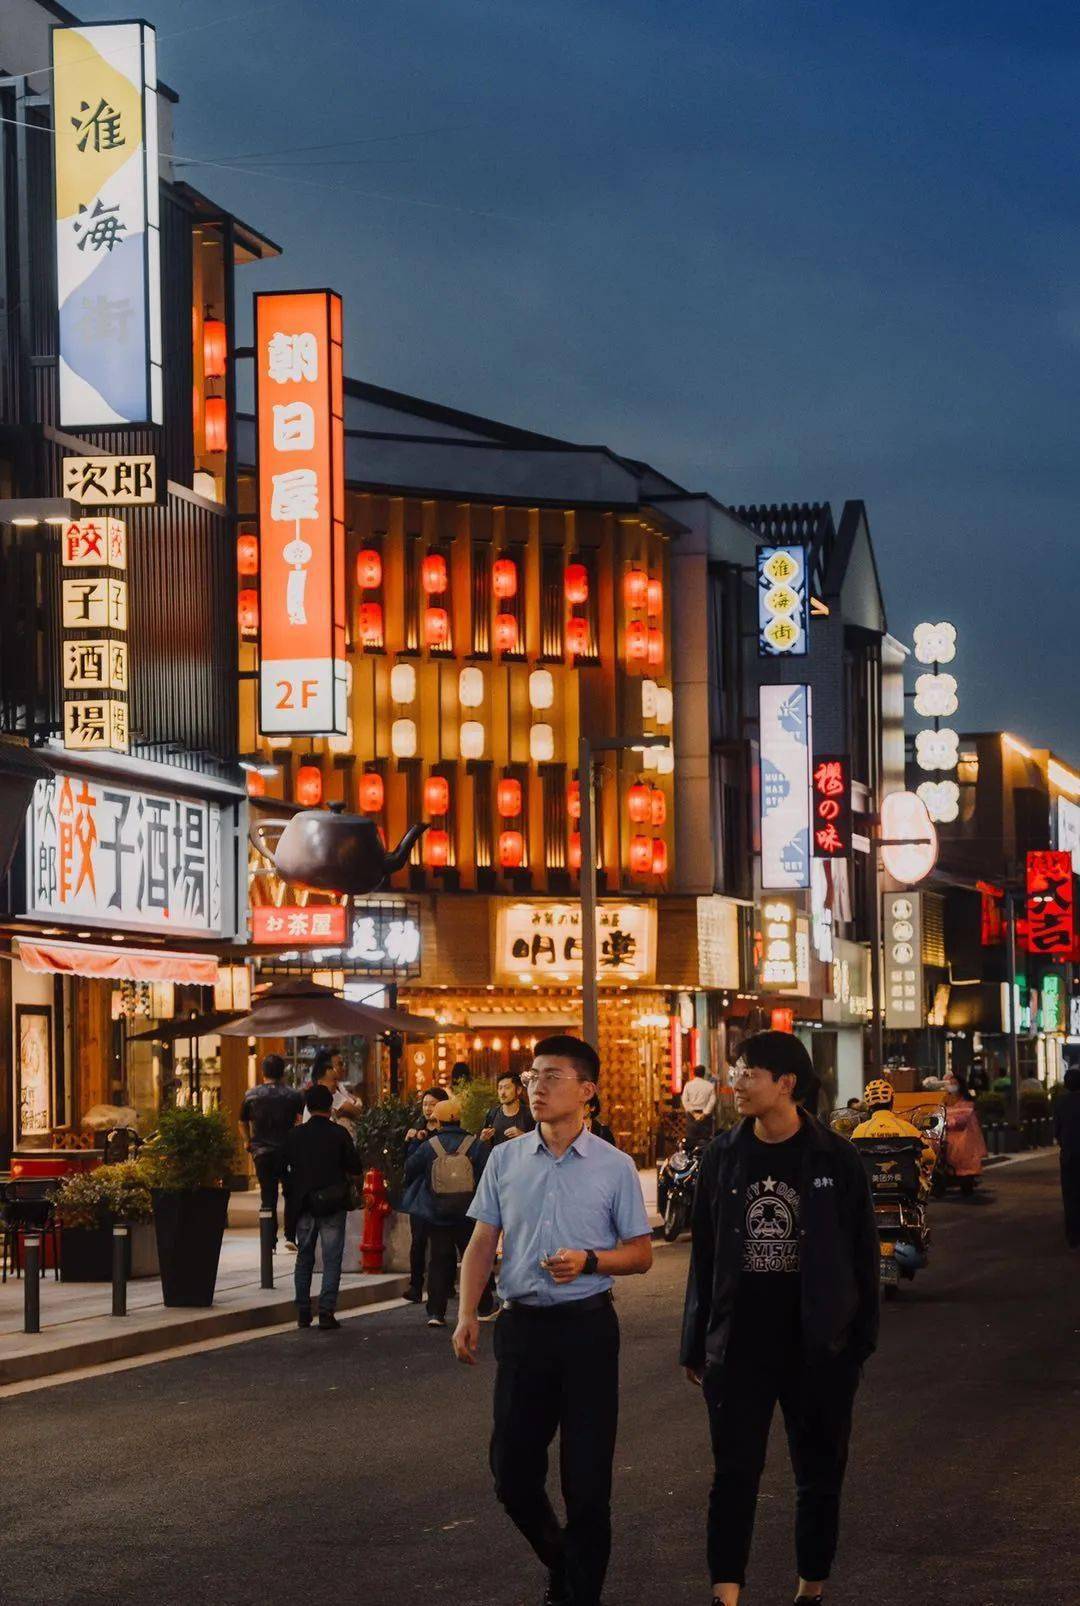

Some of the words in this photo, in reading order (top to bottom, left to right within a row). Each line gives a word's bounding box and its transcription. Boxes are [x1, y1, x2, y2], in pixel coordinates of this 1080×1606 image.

[71, 97, 135, 342] 淮海街
[66, 462, 153, 498] 次郎
[66, 523, 104, 743] 餃子酒場
[772, 559, 792, 640] 淮海街
[274, 679, 320, 710] 2F
[57, 775, 205, 920] 餃子酒場
[266, 913, 332, 937] お茶屋
